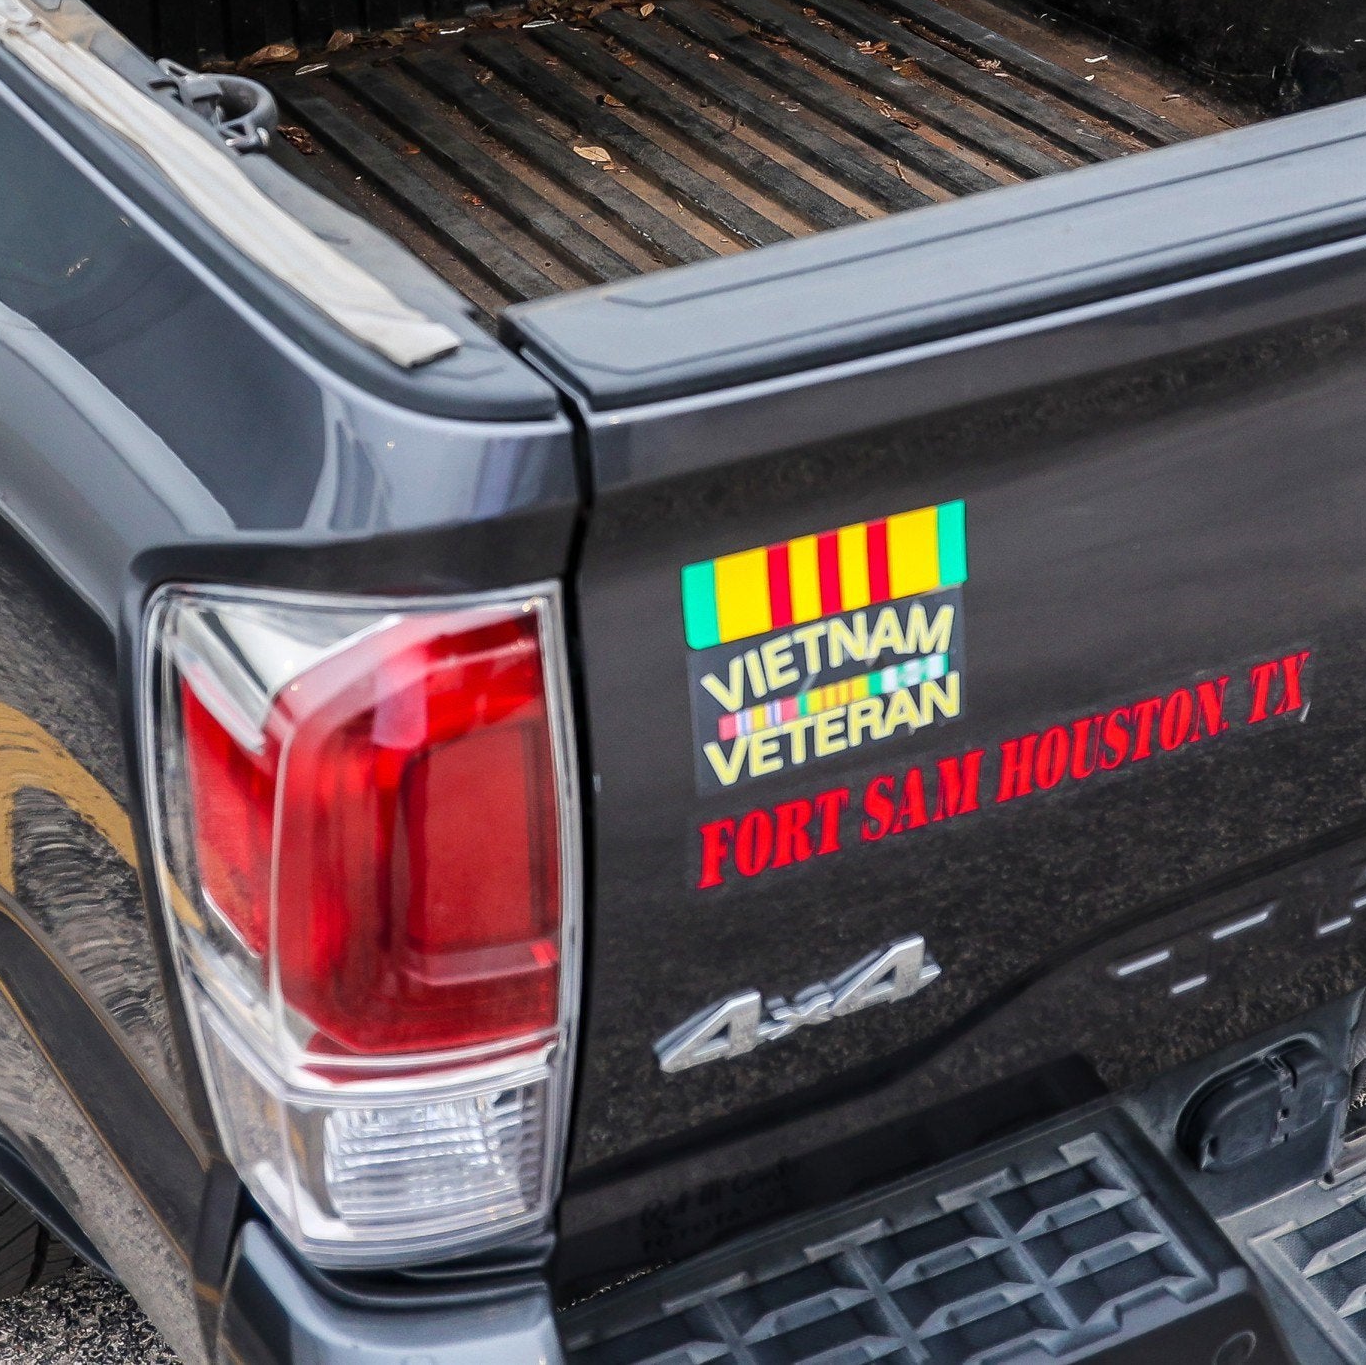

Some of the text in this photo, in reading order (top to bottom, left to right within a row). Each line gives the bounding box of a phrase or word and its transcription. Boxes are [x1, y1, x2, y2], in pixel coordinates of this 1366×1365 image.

[700, 603, 954, 713] VIETNAM
[697, 787, 849, 889] FORT
[861, 750, 984, 843] SAM
[1248, 651, 1310, 724] TX
[703, 671, 960, 786] VETERAN
